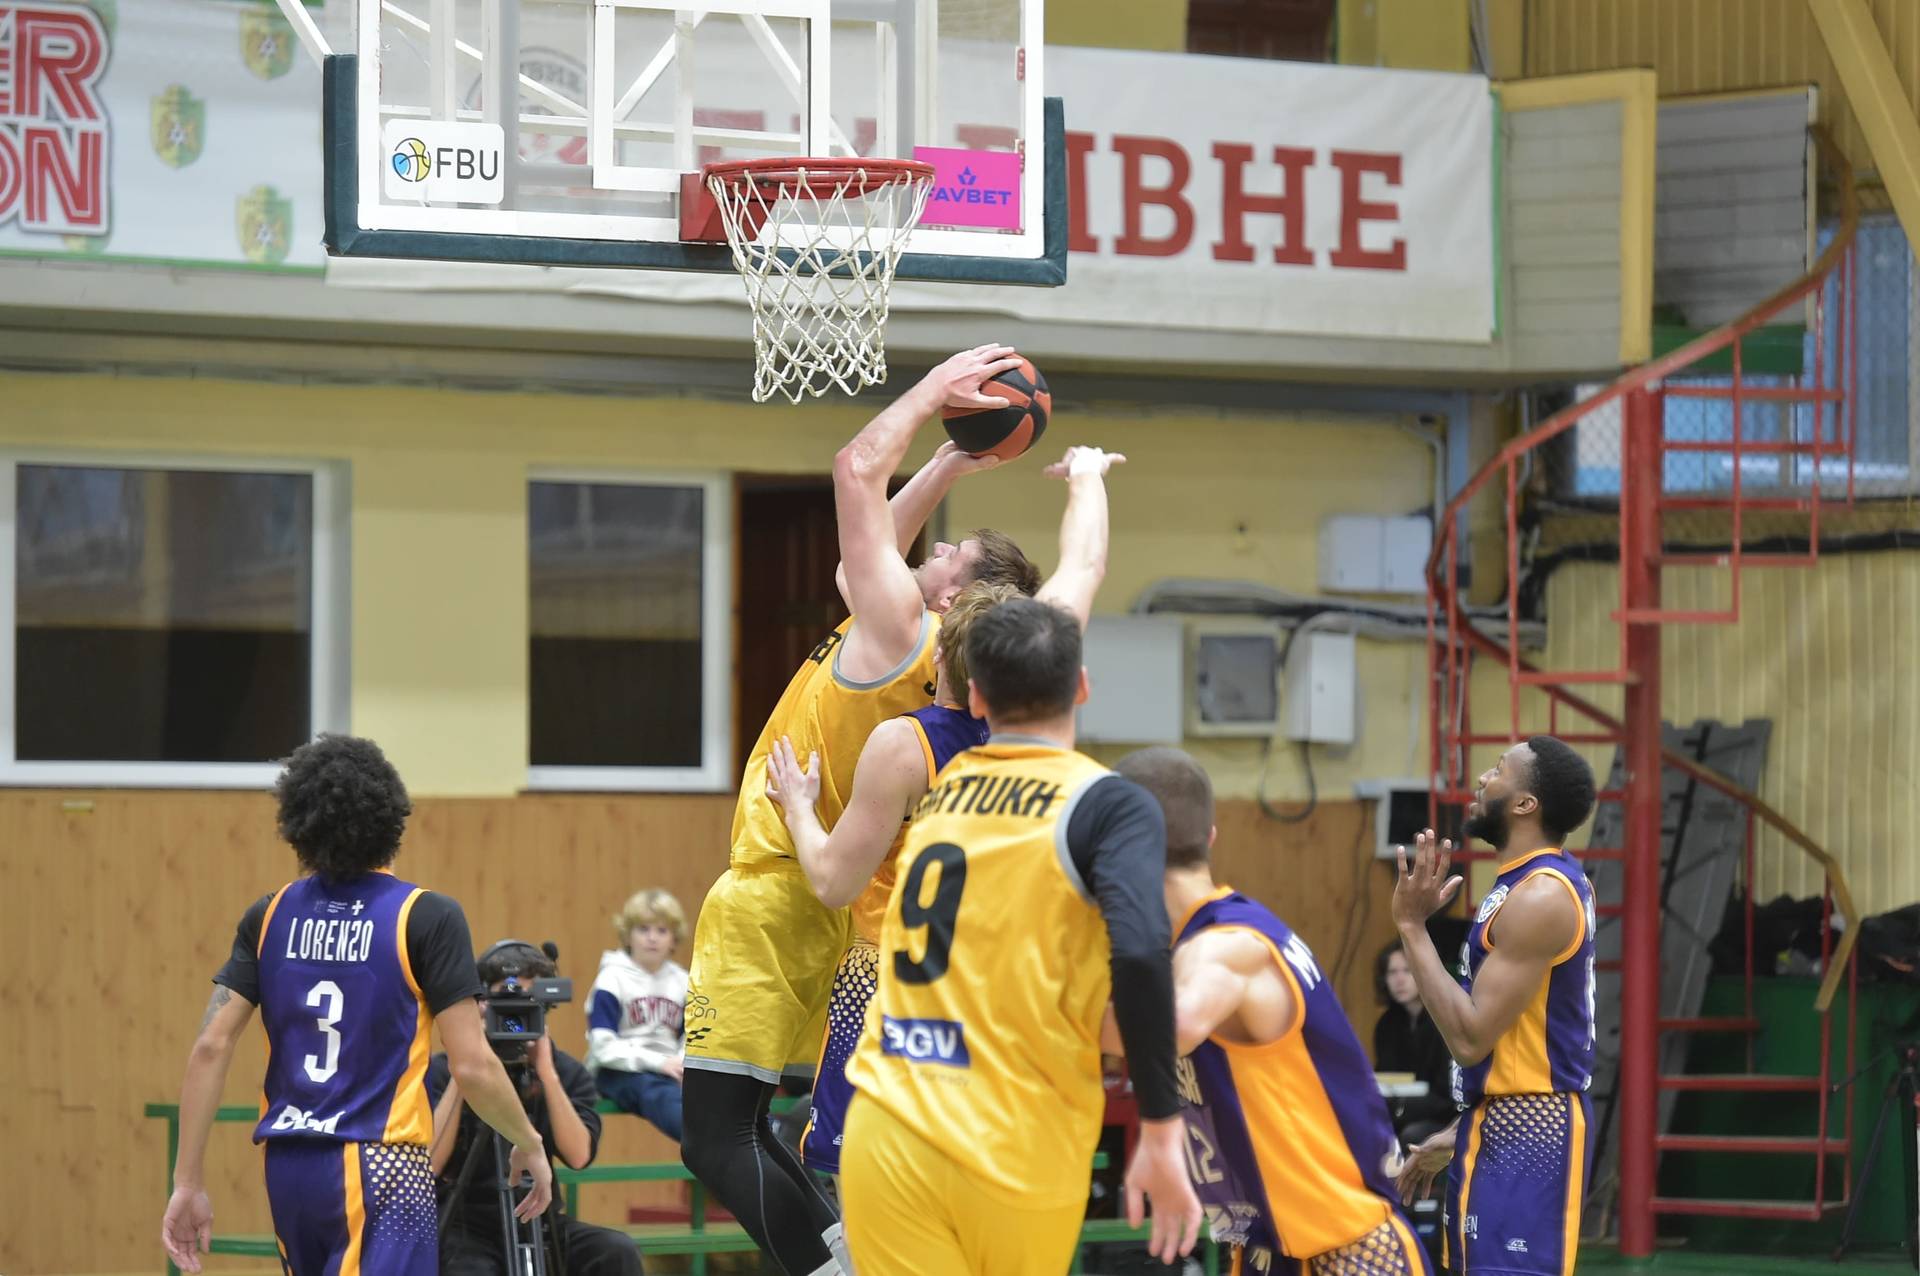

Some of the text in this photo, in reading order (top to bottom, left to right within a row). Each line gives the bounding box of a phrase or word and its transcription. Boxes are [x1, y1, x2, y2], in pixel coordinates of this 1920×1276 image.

[0, 9, 101, 120] R
[436, 147, 499, 181] FBU
[285, 916, 375, 963] LORENZO
[893, 842, 967, 985] 9
[303, 980, 344, 1084] 3
